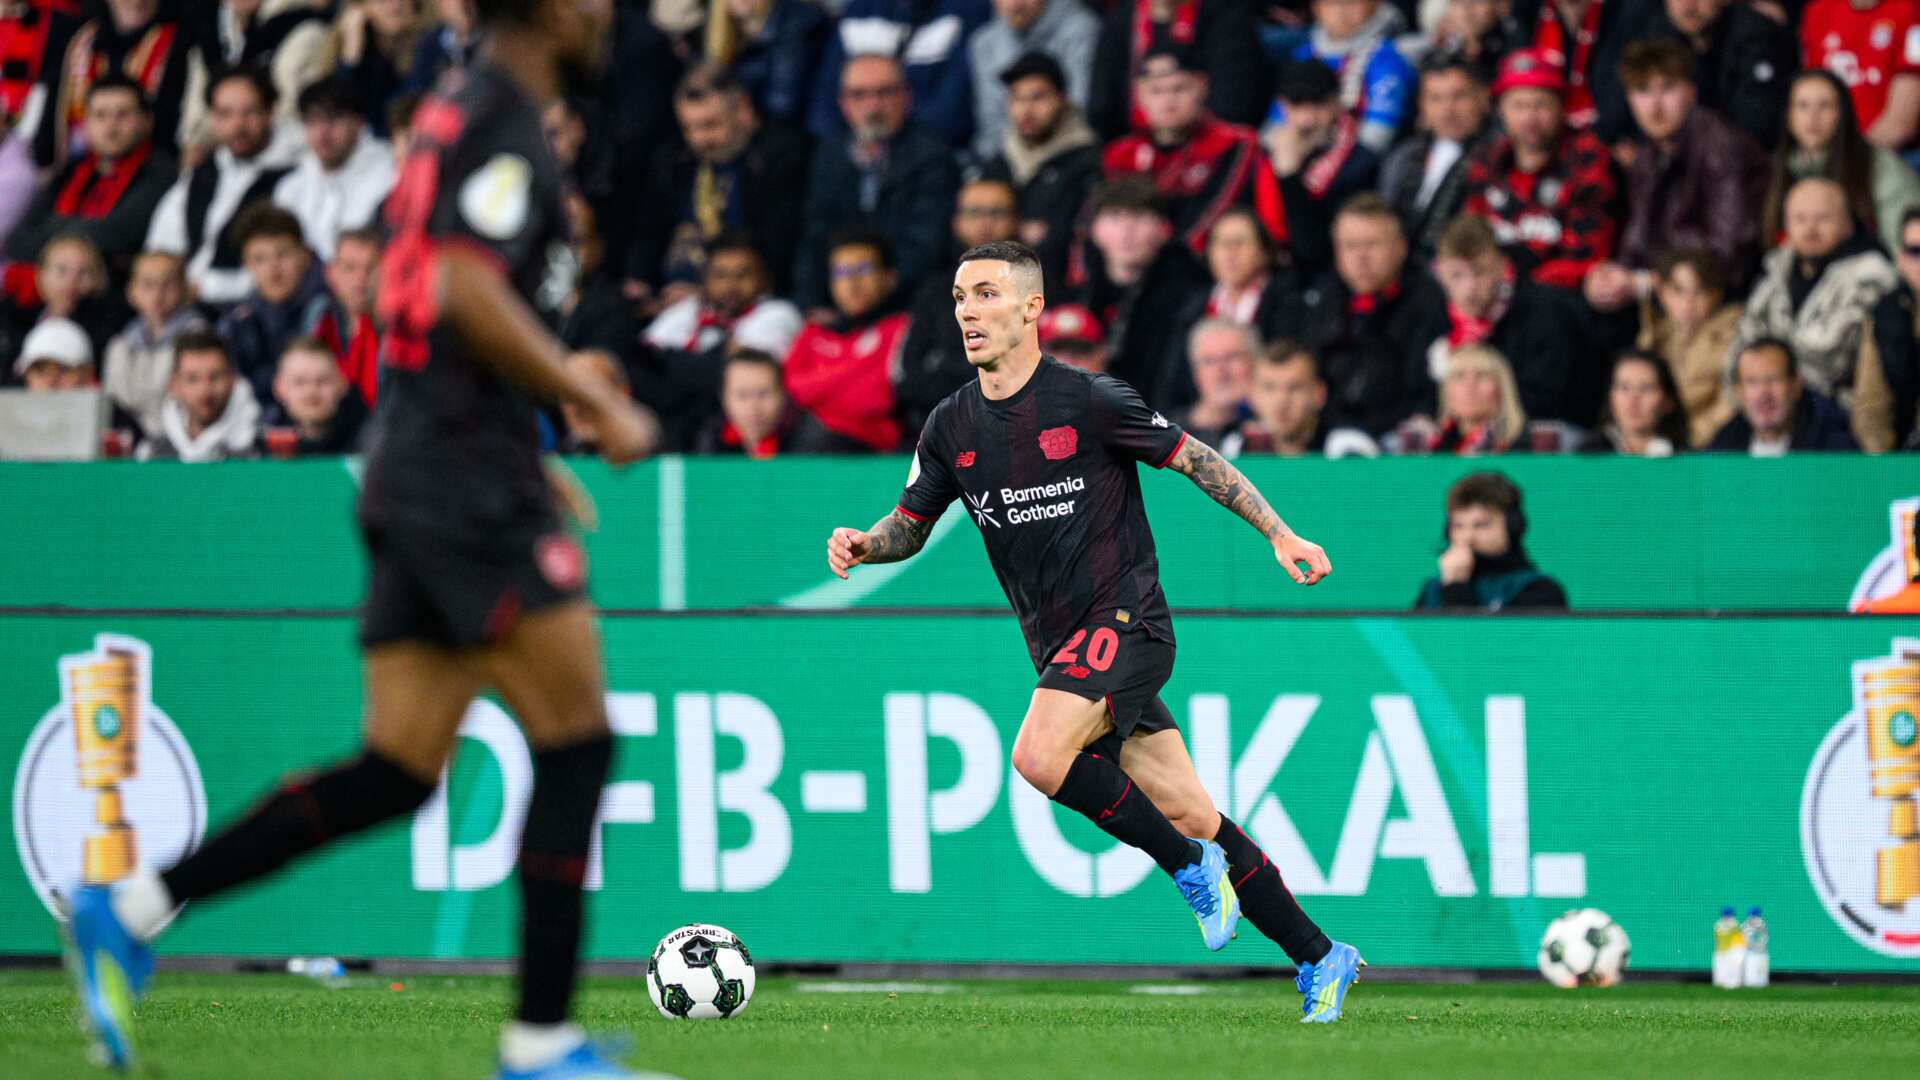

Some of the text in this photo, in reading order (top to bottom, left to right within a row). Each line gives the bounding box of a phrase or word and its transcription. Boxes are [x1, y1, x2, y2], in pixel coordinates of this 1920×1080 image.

[1000, 476, 1085, 504] Barmenia
[1007, 500, 1076, 525] Gothaer
[1051, 626, 1119, 672] 20
[668, 928, 729, 945] ERBYSTAR
